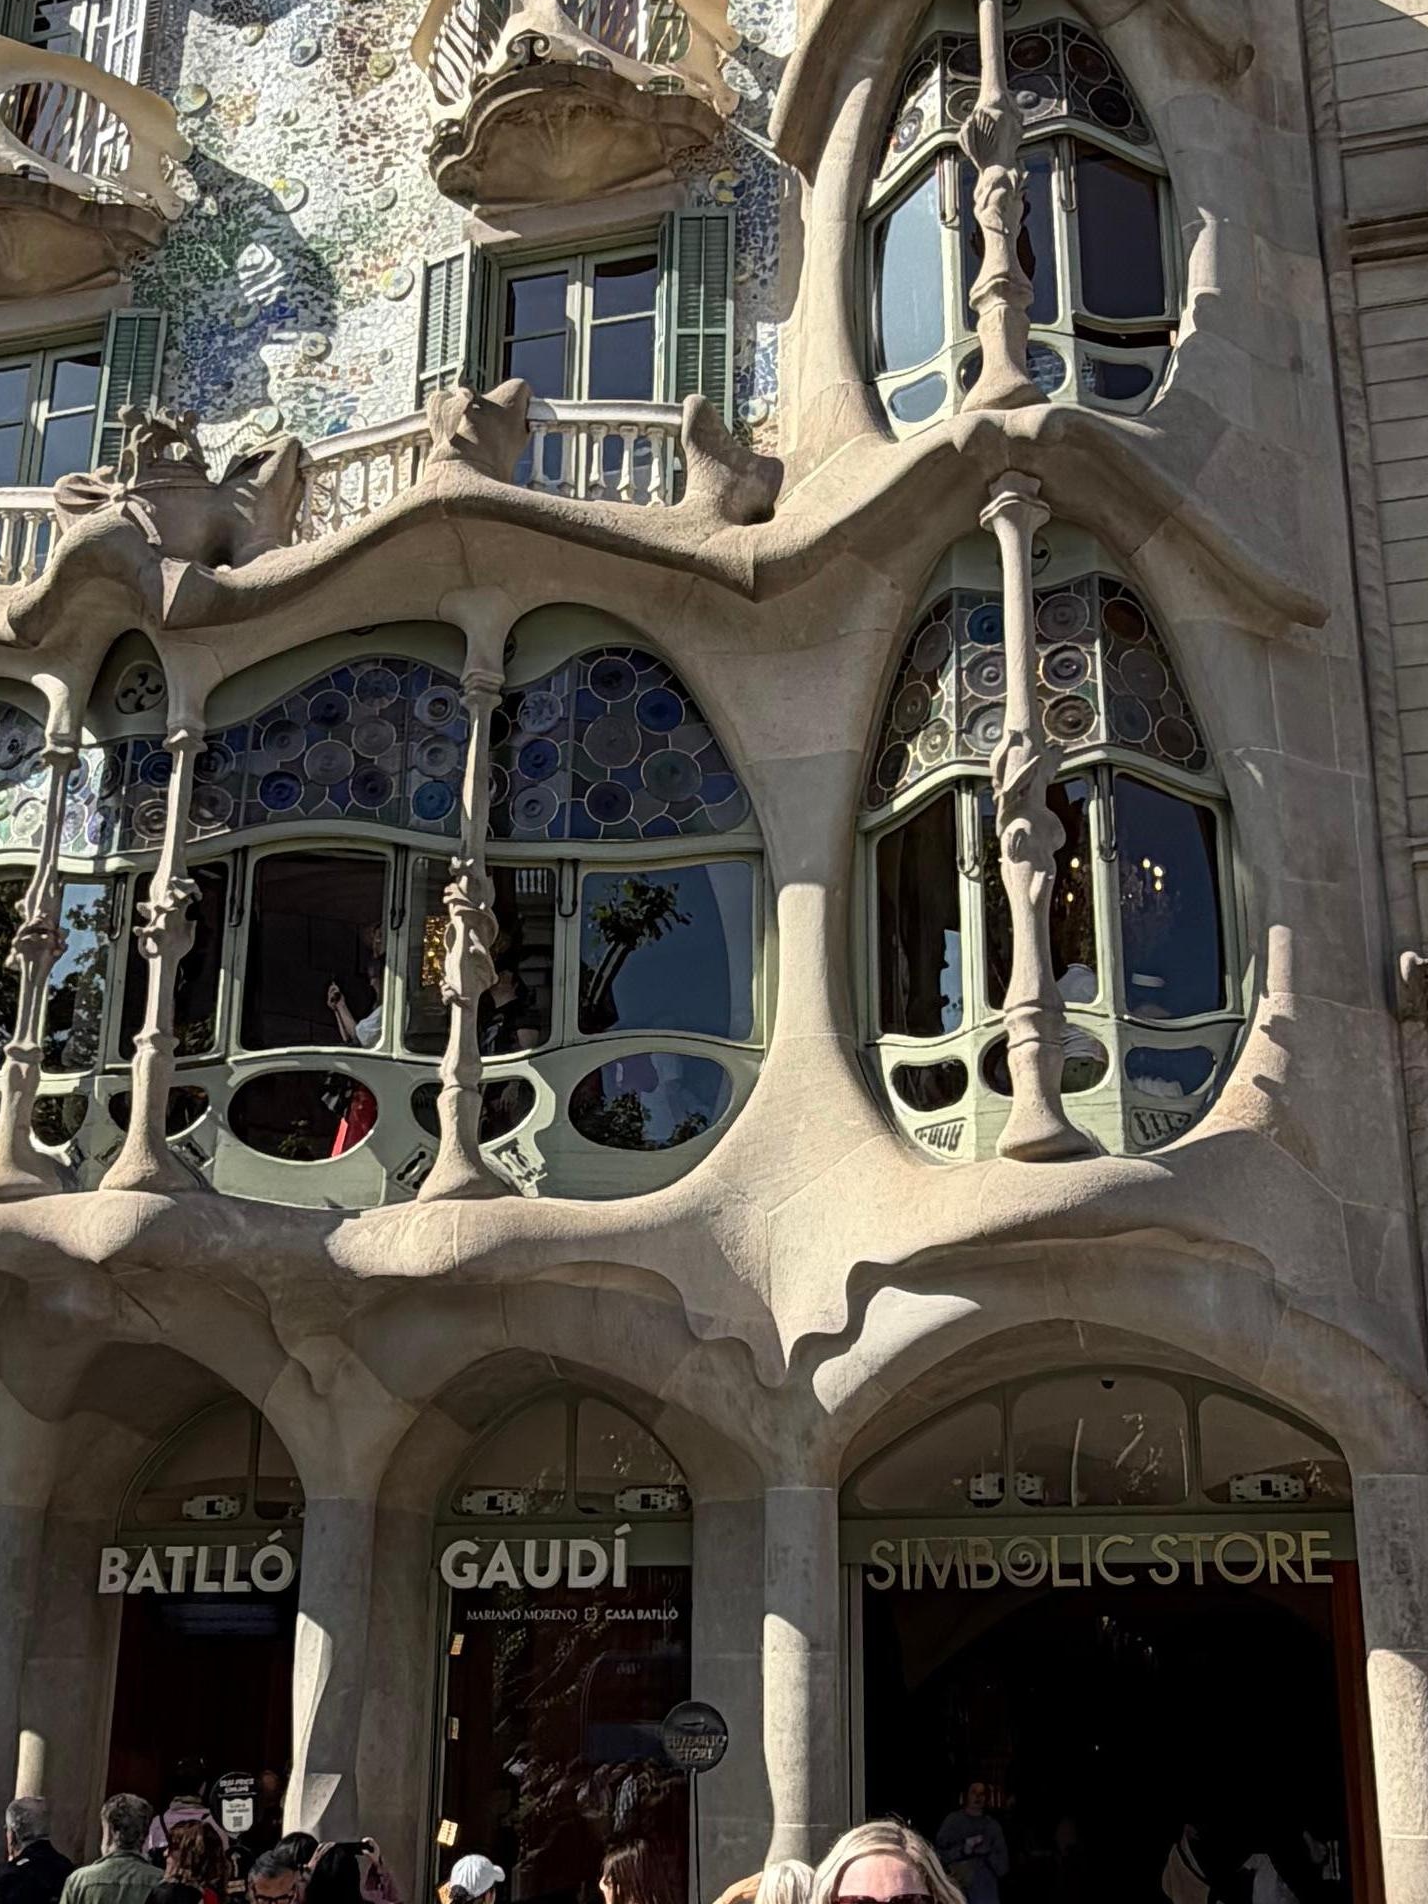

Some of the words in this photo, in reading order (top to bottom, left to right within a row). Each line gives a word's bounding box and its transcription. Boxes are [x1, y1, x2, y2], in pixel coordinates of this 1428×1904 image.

[98, 1529, 295, 1594] BATLLÓ
[440, 1523, 632, 1589] GAUDÍ
[867, 1535, 1135, 1591] SIMBOLIC
[1149, 1530, 1333, 1586] STORE
[466, 1608, 521, 1622] MARIANO
[524, 1608, 578, 1622] MORENO
[605, 1608, 635, 1621] CASA
